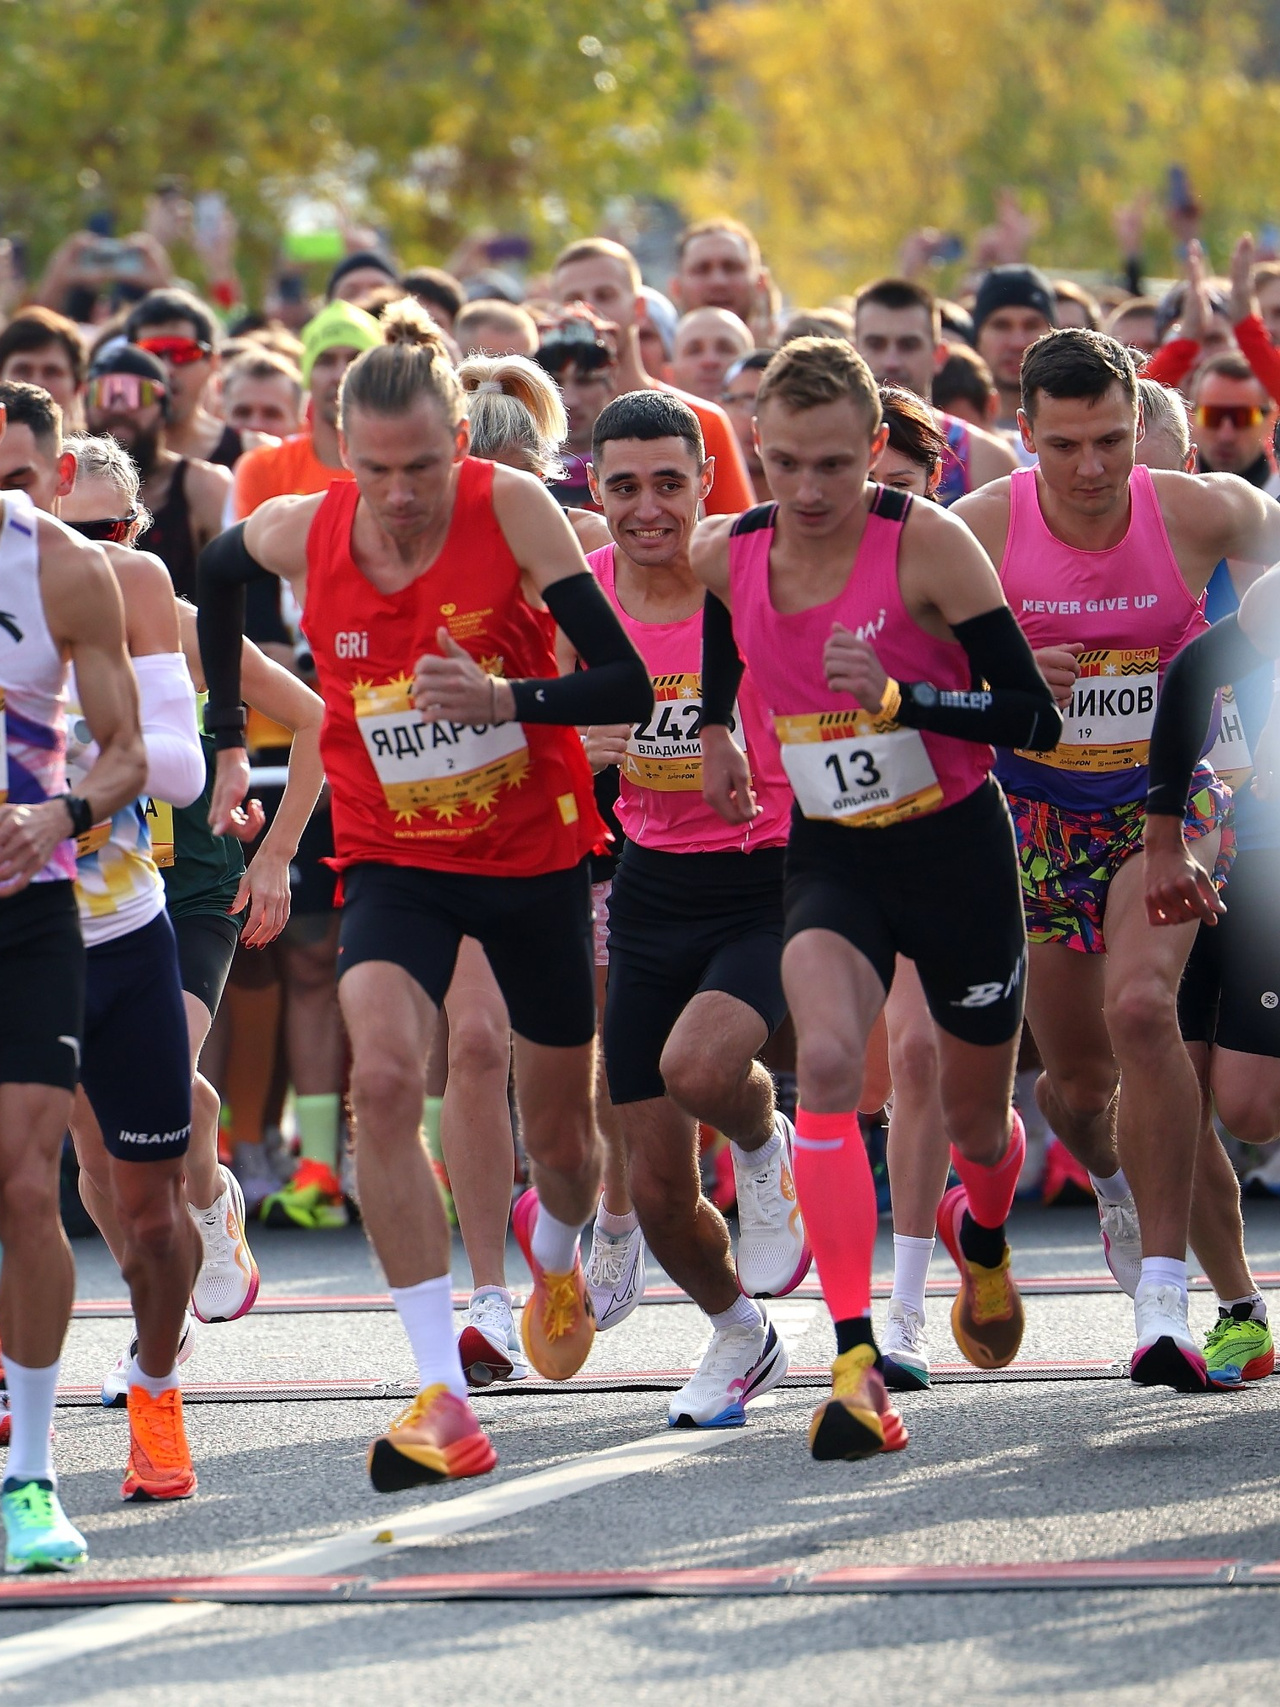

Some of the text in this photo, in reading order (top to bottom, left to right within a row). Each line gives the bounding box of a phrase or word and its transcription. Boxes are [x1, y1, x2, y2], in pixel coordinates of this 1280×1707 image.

[1022, 594, 1158, 615] NEVER GIVE UP
[335, 630, 369, 659] GRi
[1121, 653, 1132, 662] 10
[371, 719, 507, 760] ЯДГАРО
[1078, 728, 1092, 739] 19
[447, 758, 455, 770] 2
[825, 750, 881, 792] 13
[833, 787, 891, 810] ОЛЬКОВ
